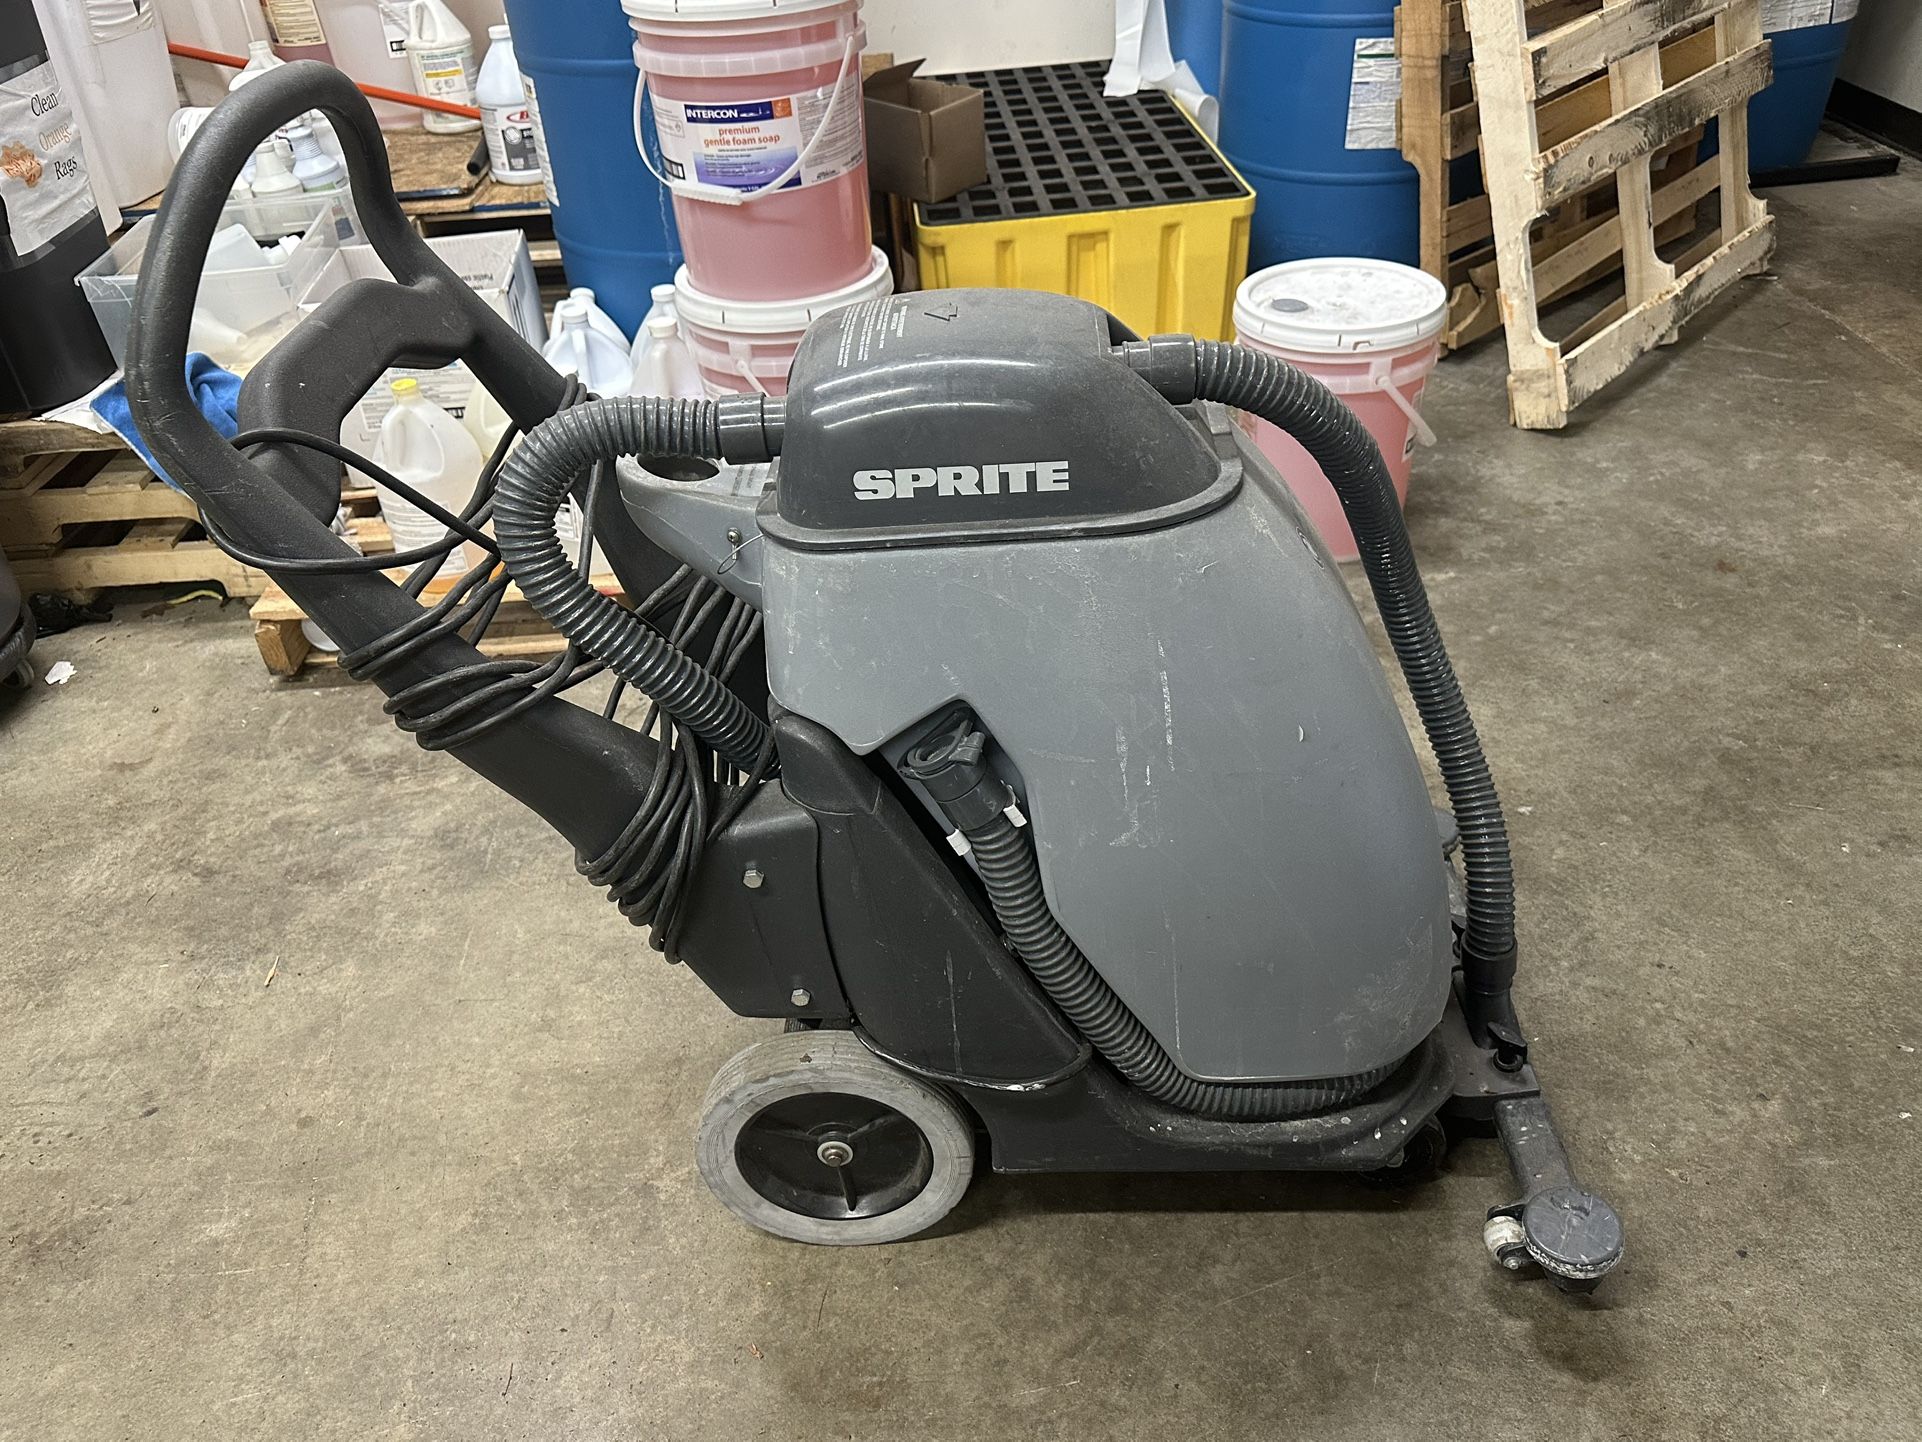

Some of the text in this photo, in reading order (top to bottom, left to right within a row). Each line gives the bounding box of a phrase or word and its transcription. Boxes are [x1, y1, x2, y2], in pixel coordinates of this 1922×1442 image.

[30, 92, 59, 117] Clean
[686, 108, 739, 119] INTERCON
[39, 122, 72, 152] Orange
[704, 134, 780, 147] gentle foam soap
[718, 126, 760, 136] premium
[54, 156, 78, 181] Rags
[852, 460, 1070, 501] SPRITE
